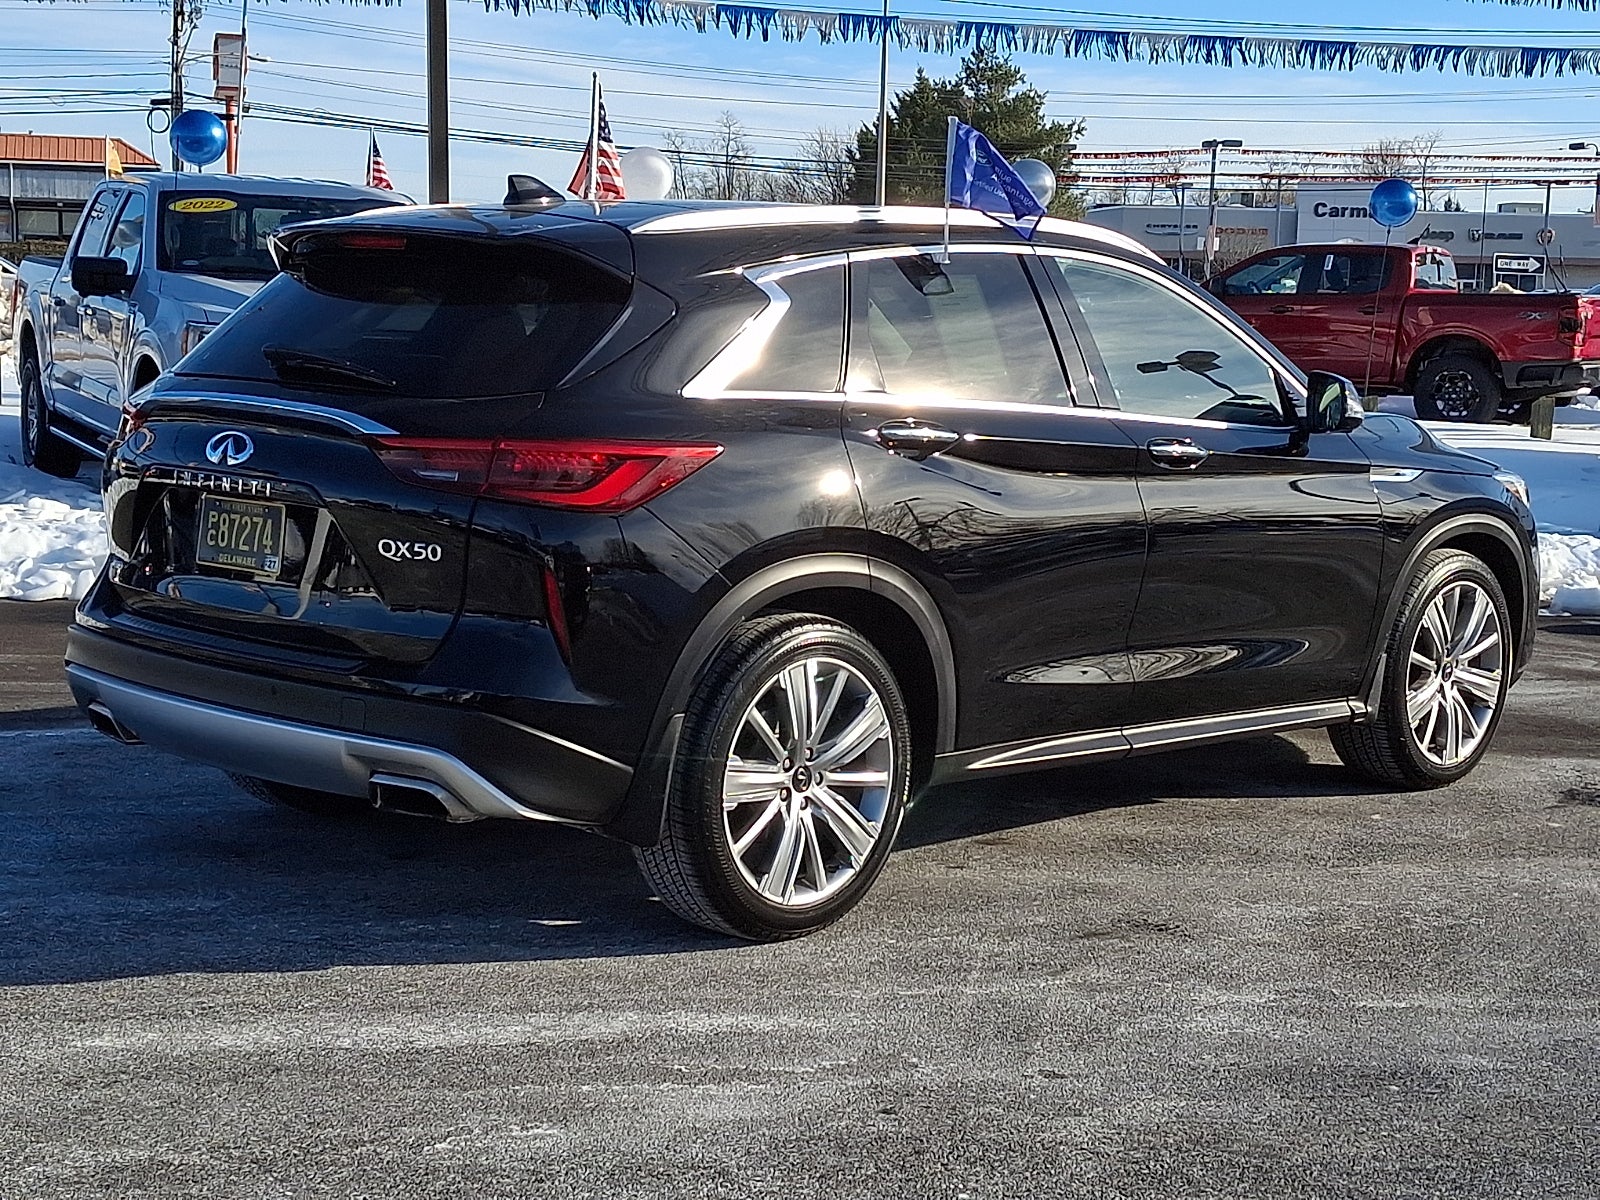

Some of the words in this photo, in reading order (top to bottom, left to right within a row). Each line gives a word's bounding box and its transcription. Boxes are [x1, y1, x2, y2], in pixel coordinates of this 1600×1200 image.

[181, 200, 226, 210] 2022
[1313, 202, 1372, 219] Carm
[174, 469, 271, 497] INFINITI
[217, 512, 273, 554] 87274
[219, 553, 257, 567] DELAWARE
[378, 539, 442, 562] QX50
